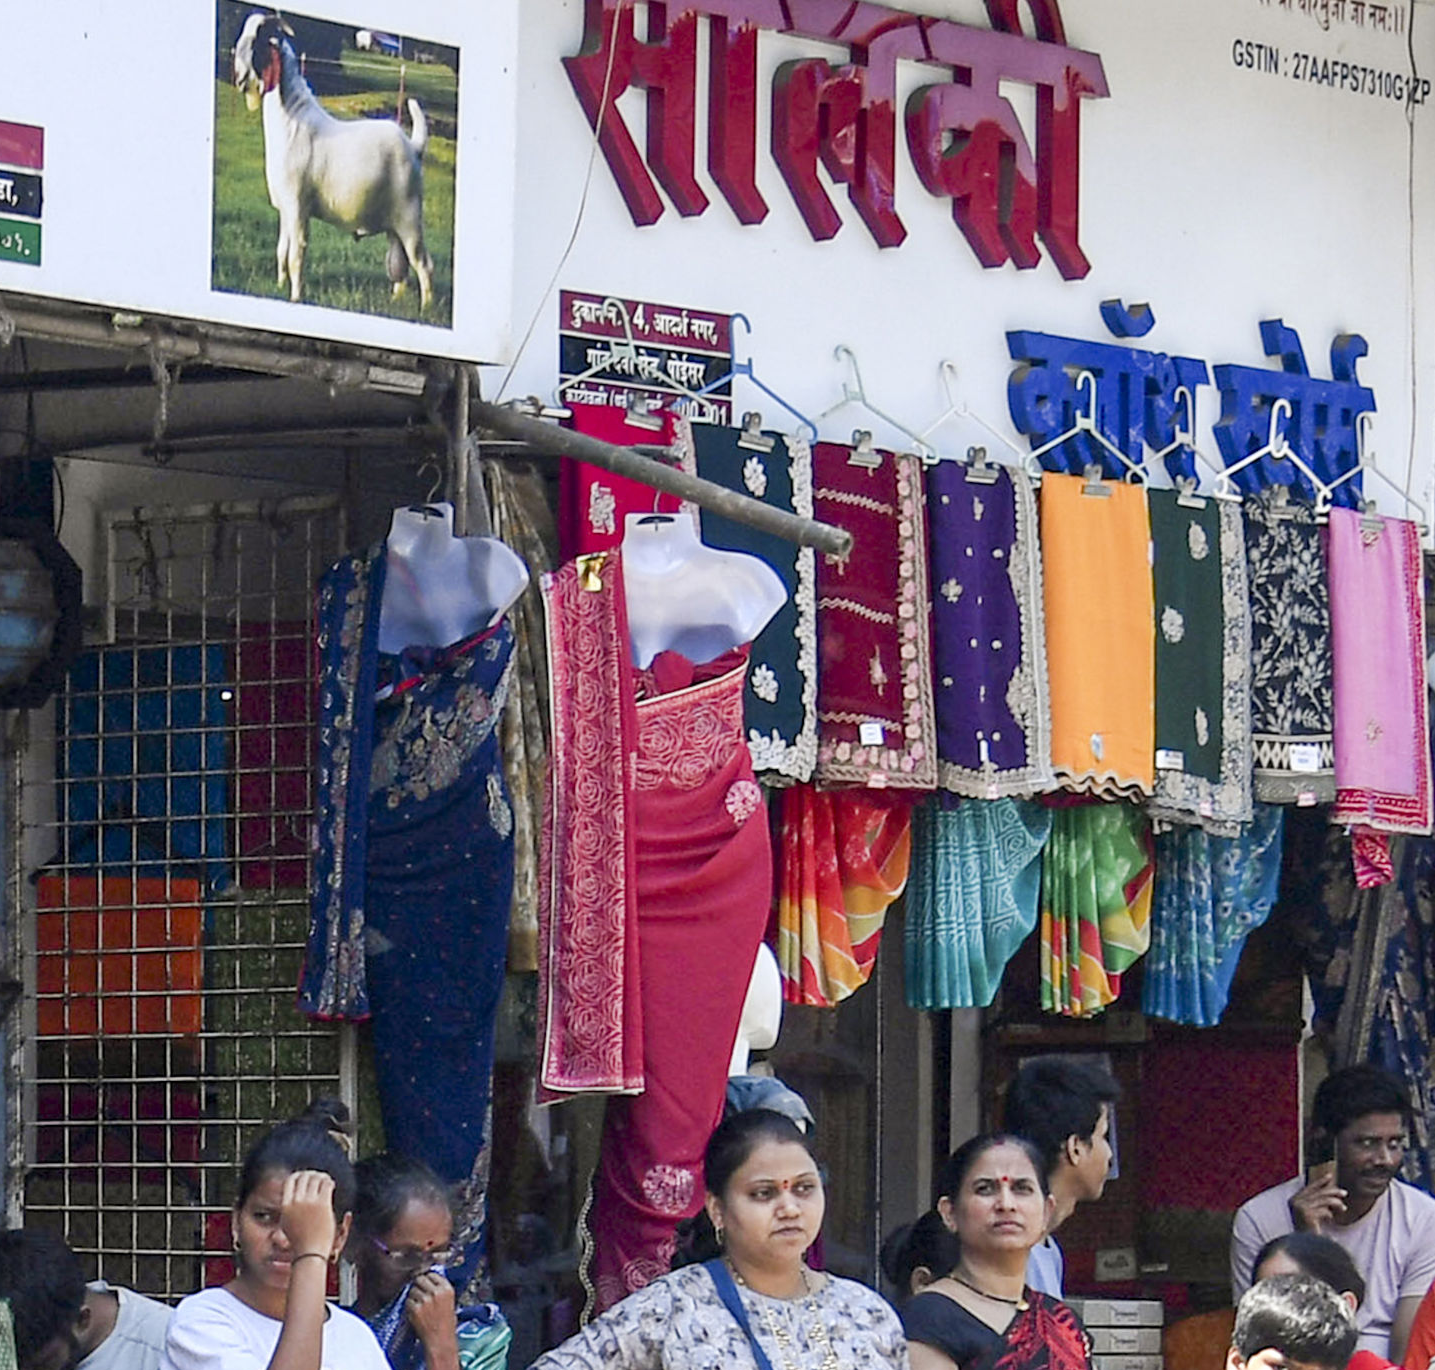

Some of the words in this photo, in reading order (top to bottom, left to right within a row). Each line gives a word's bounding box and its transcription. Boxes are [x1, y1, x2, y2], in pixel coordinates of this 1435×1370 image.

[1232, 39, 1279, 75] GSTIN
[632, 303, 650, 335] 4,
[653, 310, 689, 339] आदर्श
[689, 317, 718, 346] नगर,
